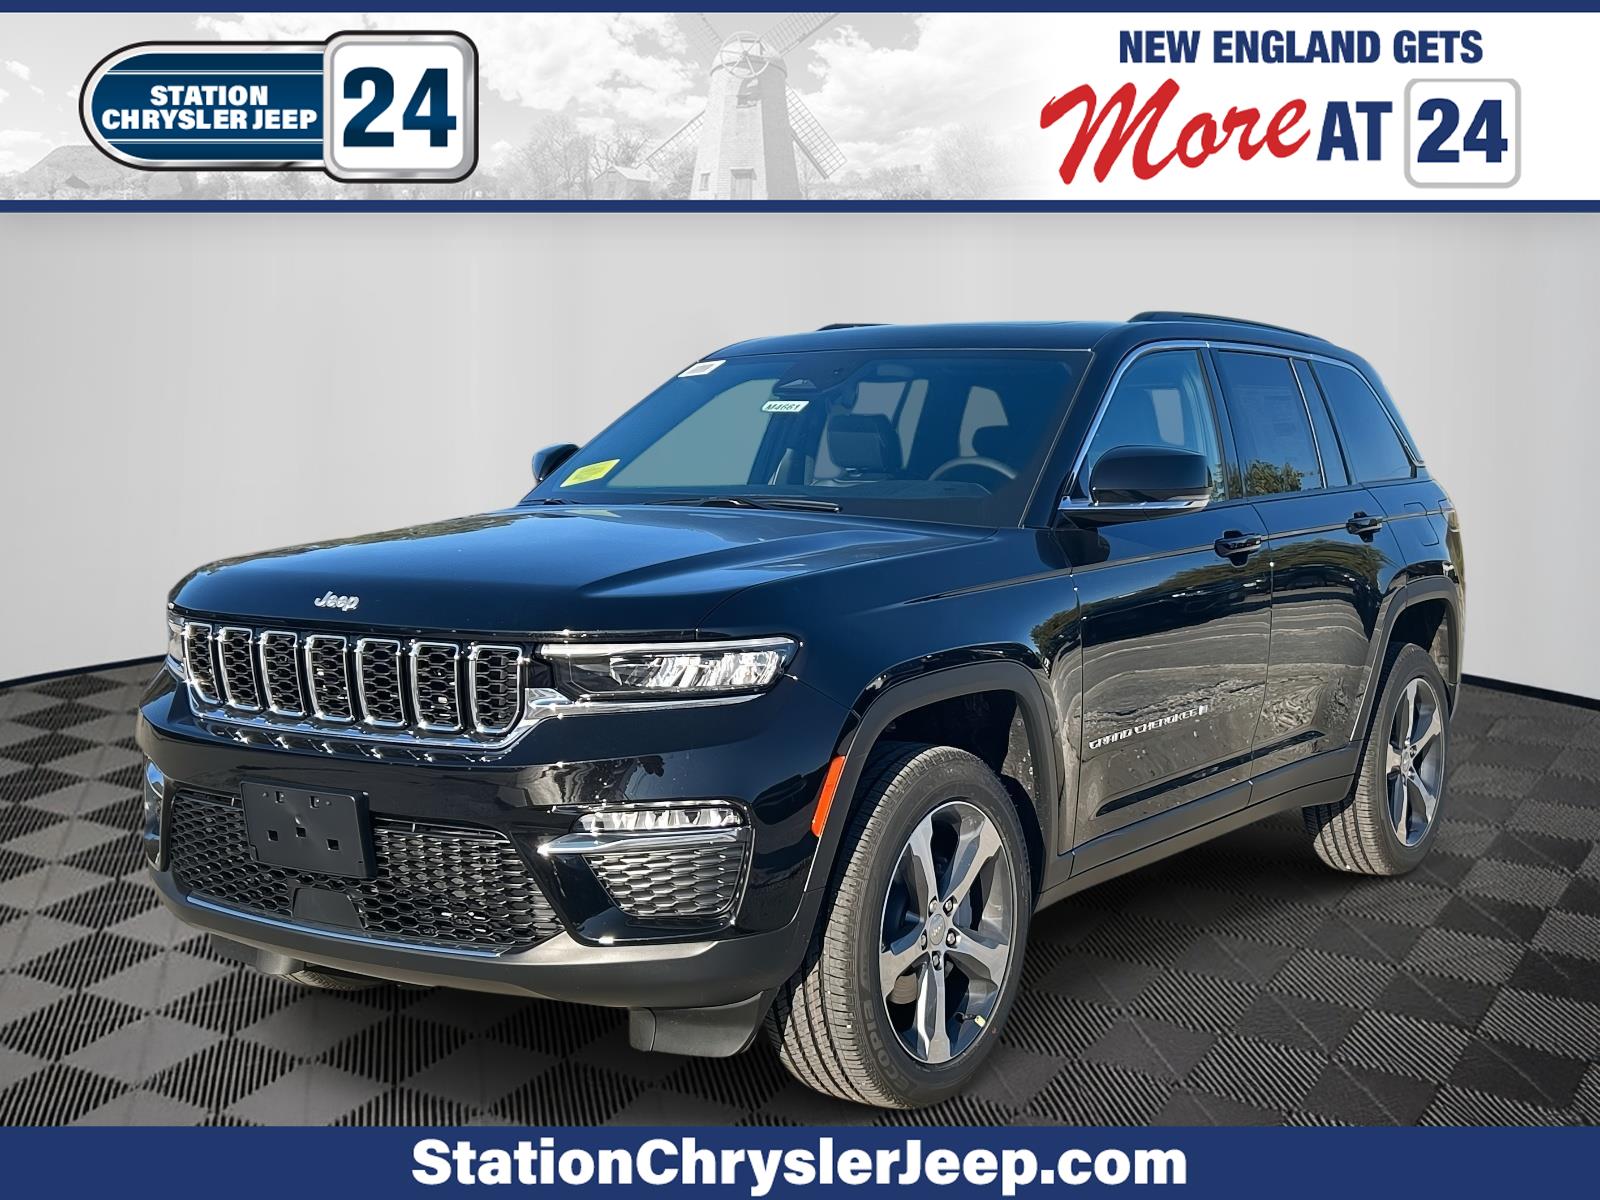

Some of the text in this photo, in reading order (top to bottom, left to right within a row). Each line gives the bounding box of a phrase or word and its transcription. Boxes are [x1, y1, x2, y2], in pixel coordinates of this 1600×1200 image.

[314, 591, 360, 612] Jeep
[1089, 708, 1198, 749] GRAND CHEROKEE
